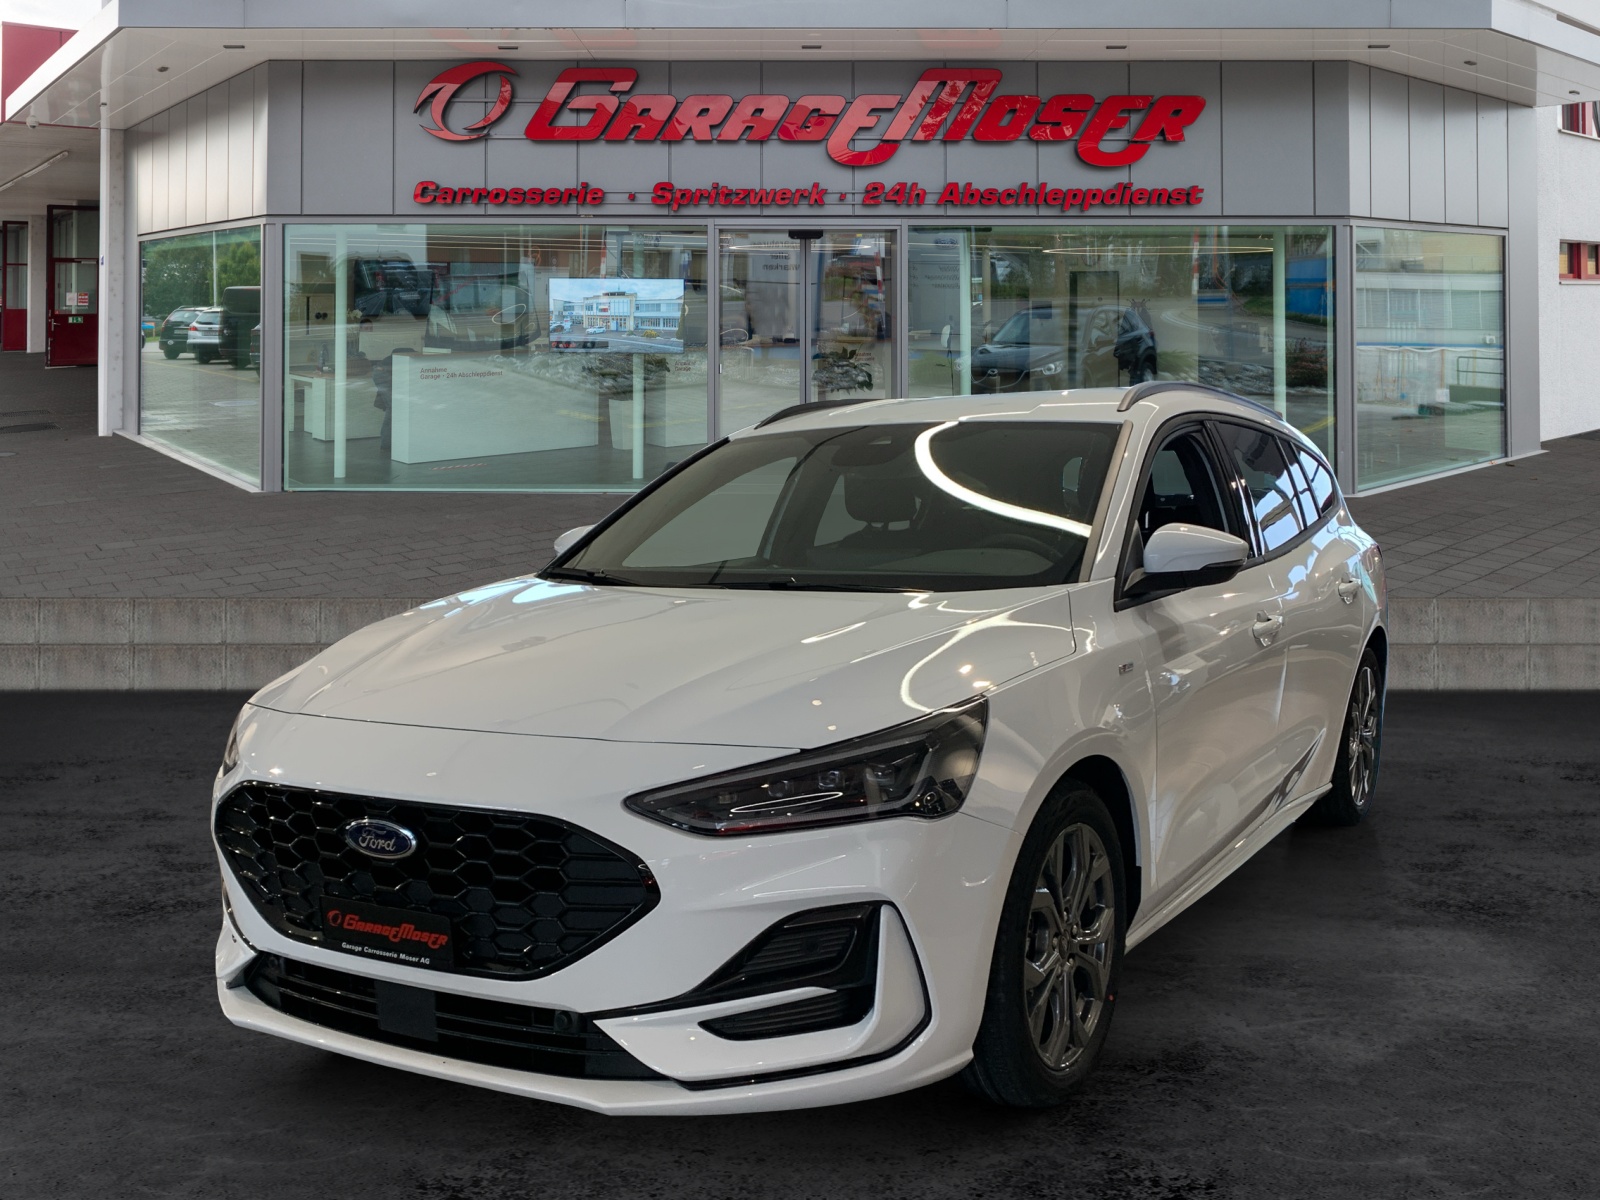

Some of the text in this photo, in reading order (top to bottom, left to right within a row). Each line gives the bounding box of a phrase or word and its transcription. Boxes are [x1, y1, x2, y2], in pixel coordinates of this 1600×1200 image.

[413, 181, 1204, 211] Carrosserie Spritzwerk 24h Abschleppdienst
[458, 370, 503, 378] Abschleppdienst
[358, 827, 396, 851] Ford
[341, 942, 431, 965] Garage Carrosserie Moser AG
